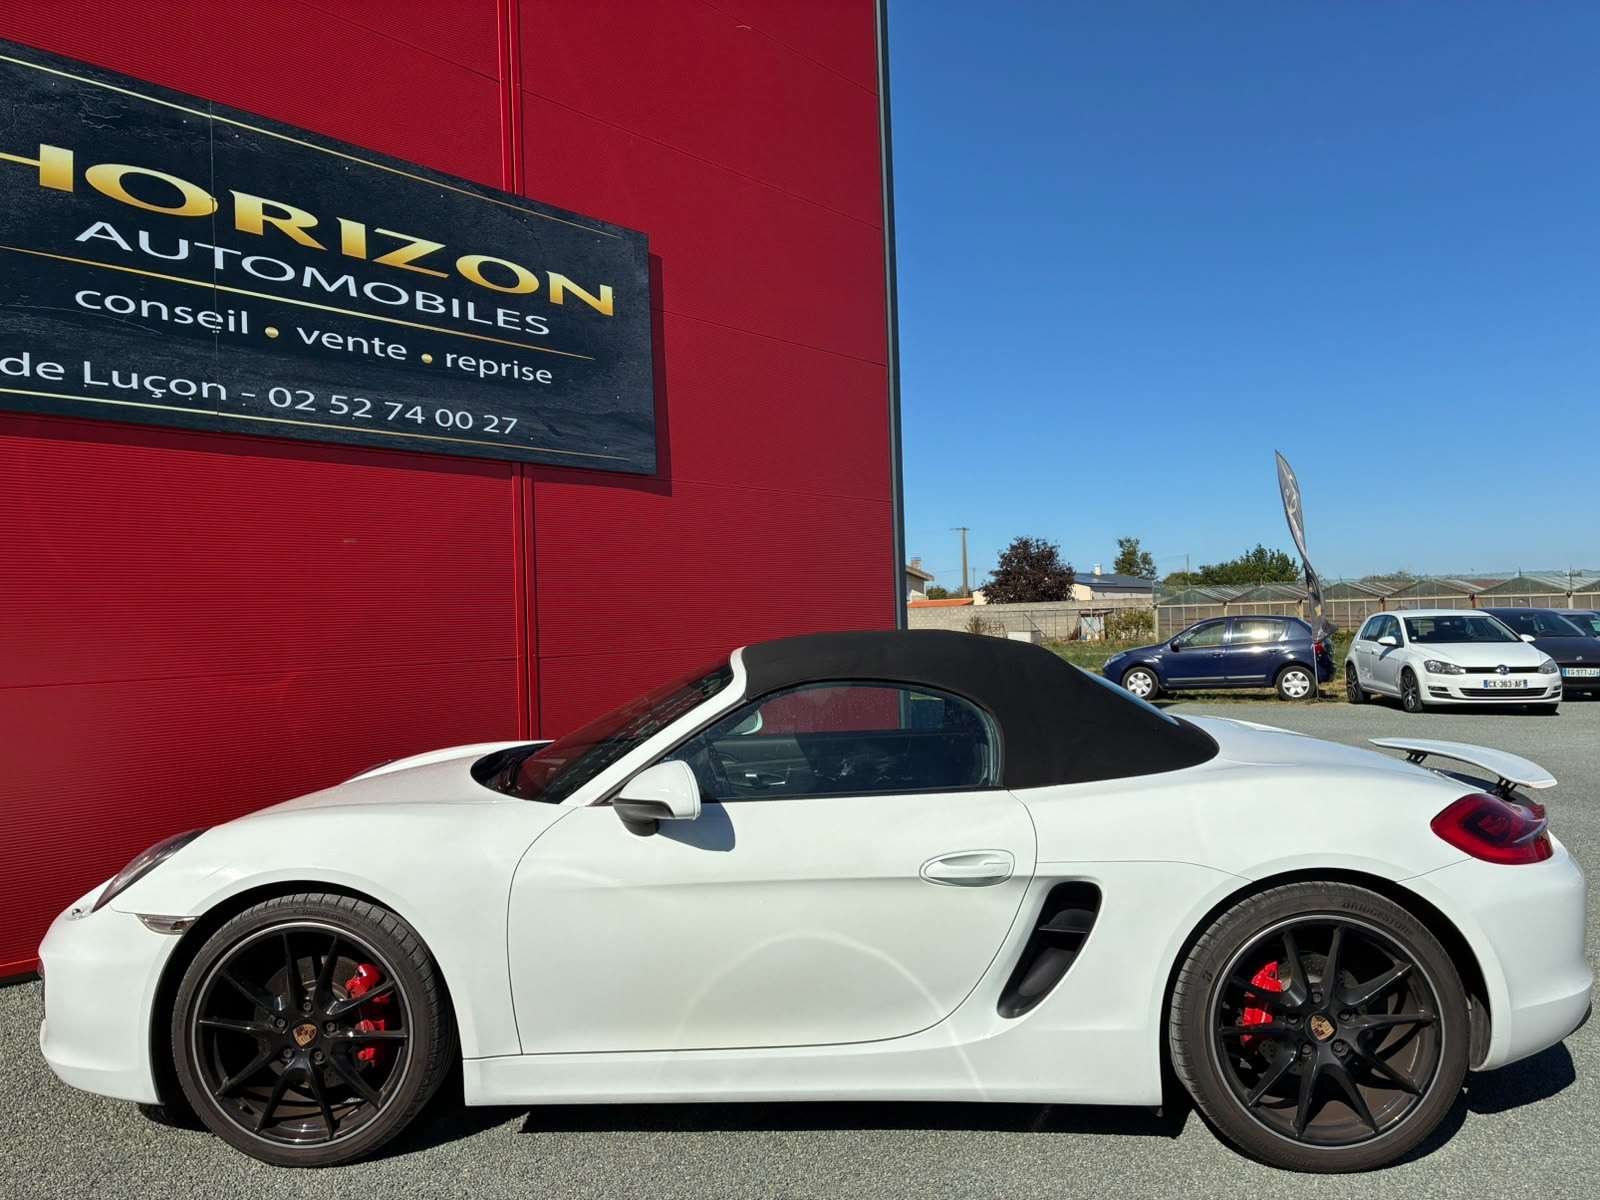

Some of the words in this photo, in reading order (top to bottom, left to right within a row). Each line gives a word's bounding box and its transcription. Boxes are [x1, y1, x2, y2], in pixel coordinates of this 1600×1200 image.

[75, 222, 549, 336] AUTOMOBILES
[75, 290, 250, 336] conseil
[297, 328, 409, 361] vente
[446, 353, 553, 384] reprise
[0, 352, 65, 380] de
[84, 361, 227, 400] Luçon
[269, 387, 317, 411] 02
[330, 395, 372, 419] 52
[385, 402, 425, 425] 74
[435, 409, 474, 430] 00
[484, 415, 519, 435] 27
